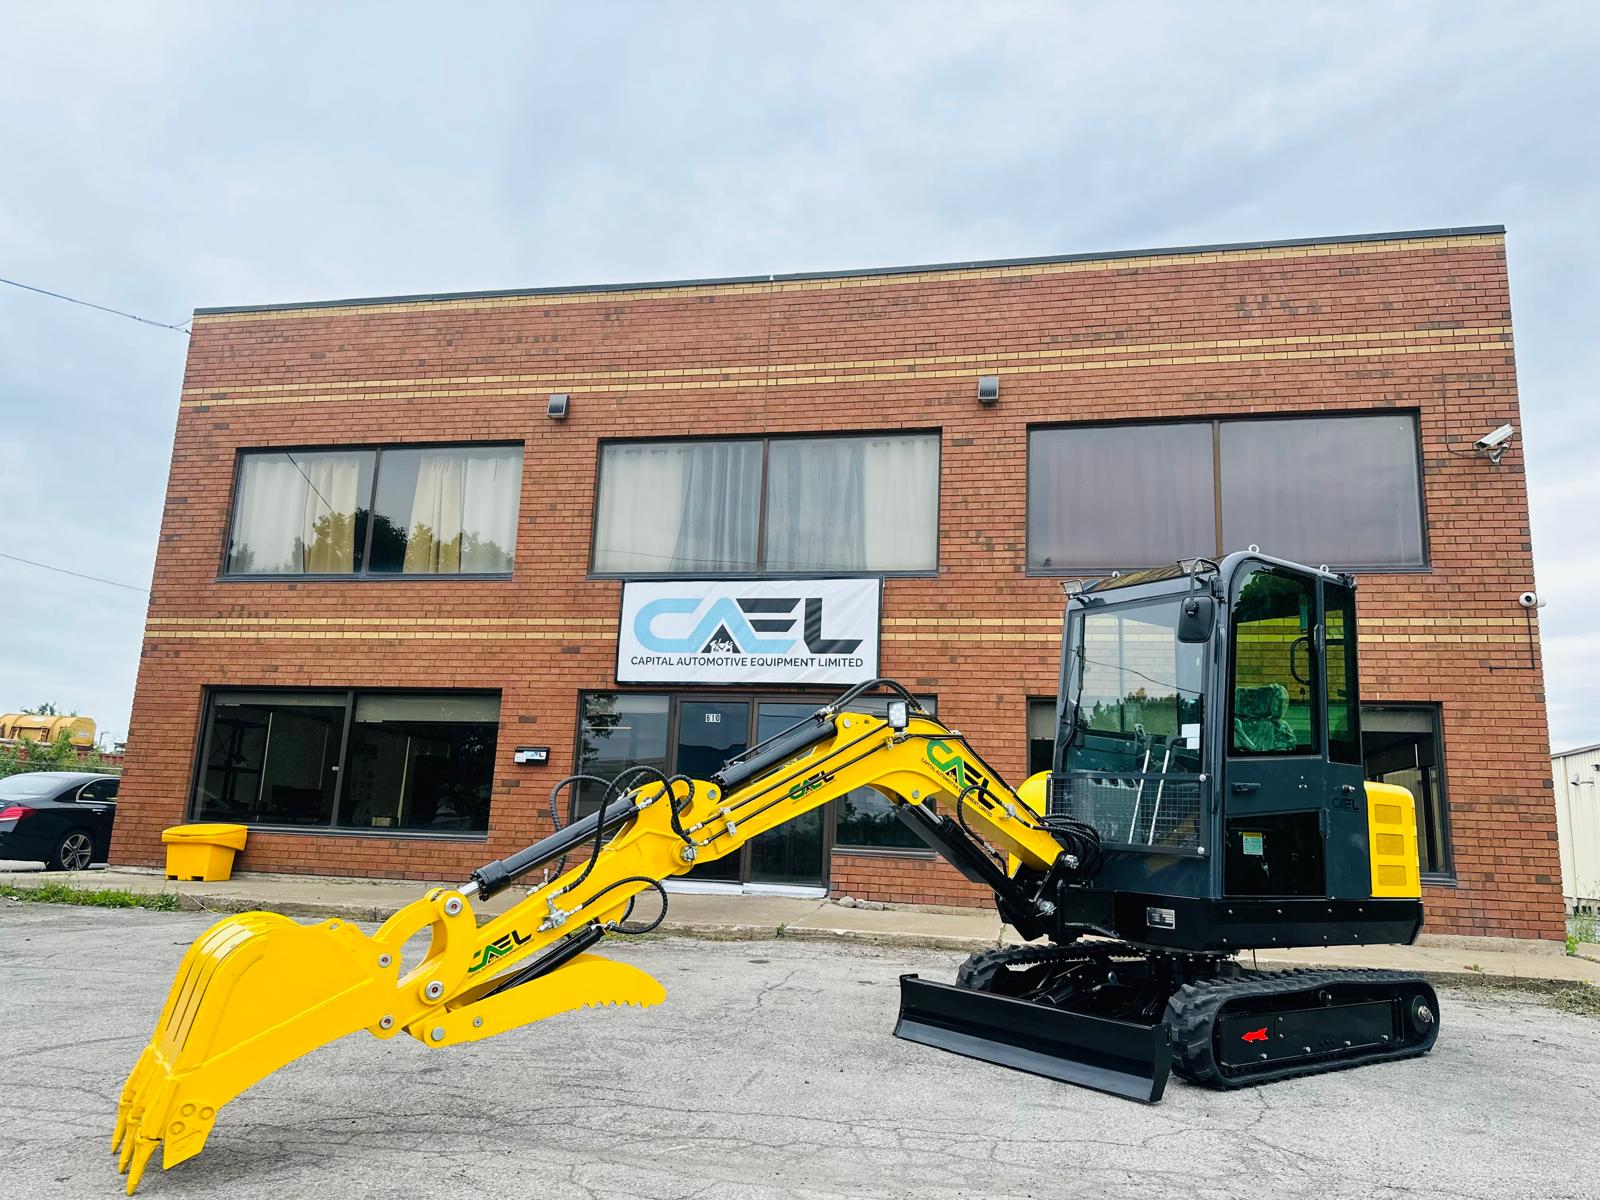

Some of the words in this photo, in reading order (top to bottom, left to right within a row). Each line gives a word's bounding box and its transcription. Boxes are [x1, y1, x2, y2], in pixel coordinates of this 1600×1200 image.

[634, 597, 863, 654] CAEL
[631, 656, 674, 666] CAPITAL
[676, 656, 748, 667] AUTOMOTIVE
[750, 657, 816, 667] EQUIPMENT
[818, 657, 864, 668] LIMITED
